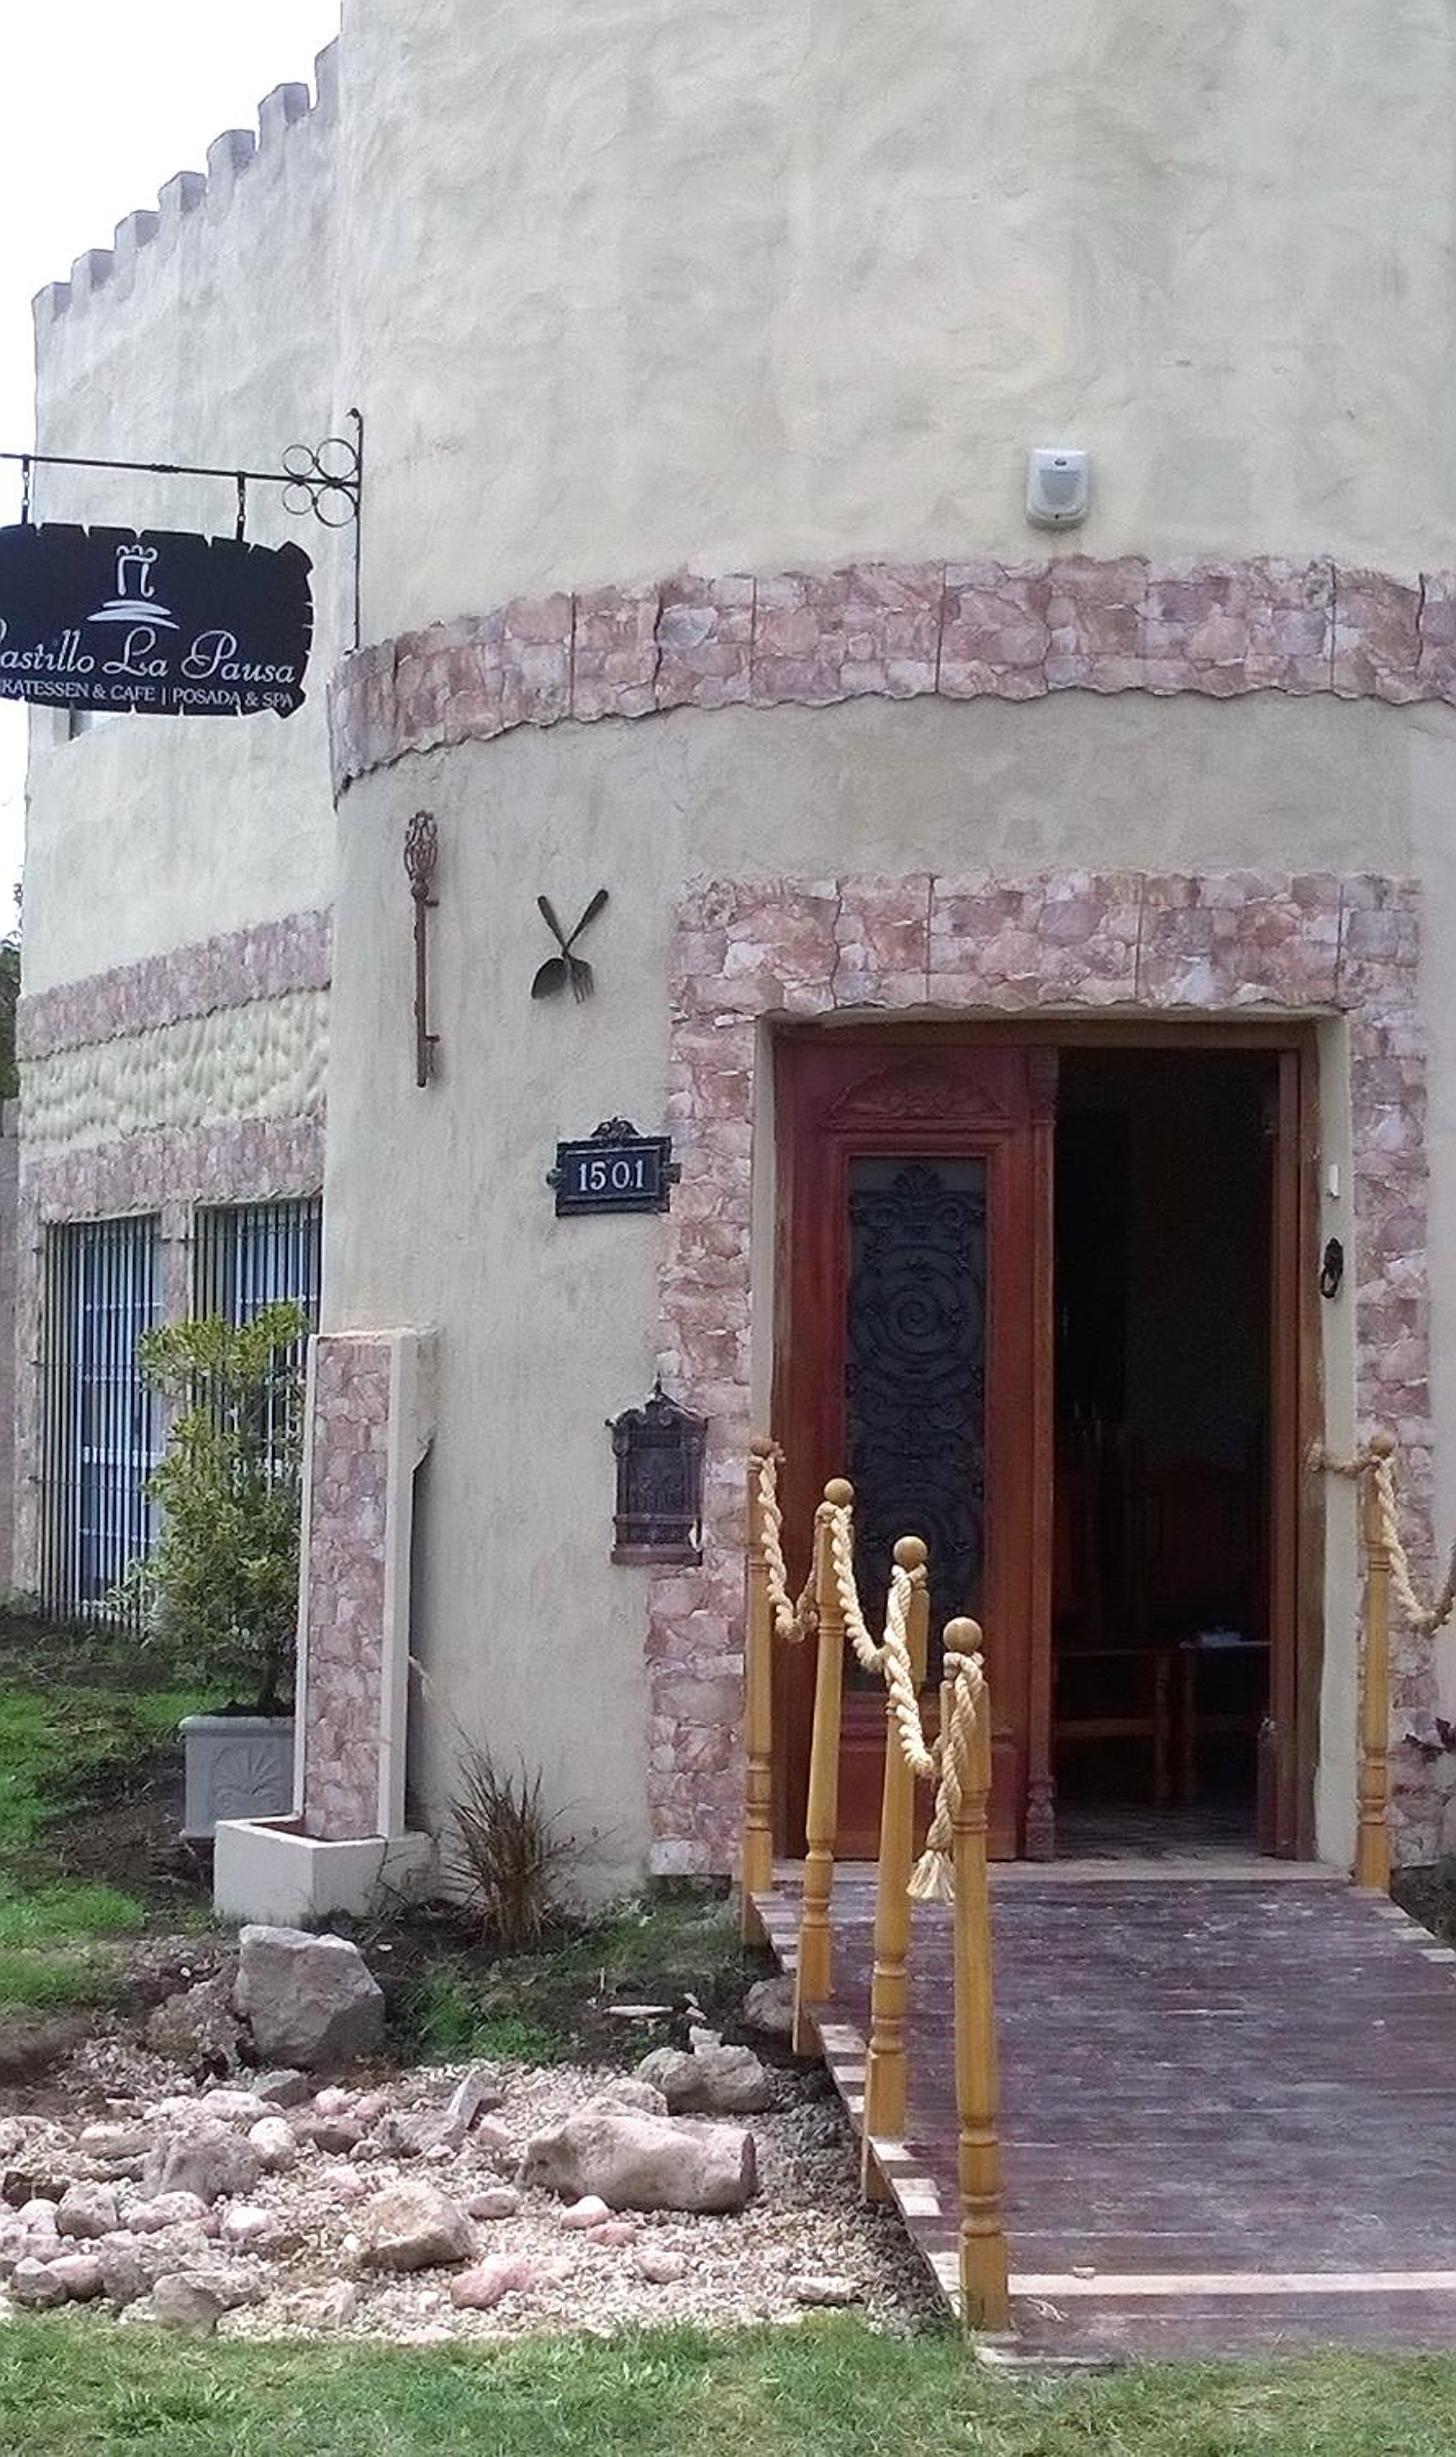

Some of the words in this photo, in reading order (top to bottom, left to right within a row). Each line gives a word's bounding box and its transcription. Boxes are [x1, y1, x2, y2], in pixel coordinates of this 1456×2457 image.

[0, 618, 95, 673] astillo
[102, 626, 169, 677] La
[181, 630, 296, 683] Pausa
[0, 679, 90, 698] KATESSEN
[92, 684, 107, 700] &
[110, 684, 156, 701] CAFE
[173, 687, 241, 706] POSADA
[245, 691, 259, 707] &
[262, 692, 294, 709] SPA
[579, 1160, 643, 1191] 1501
